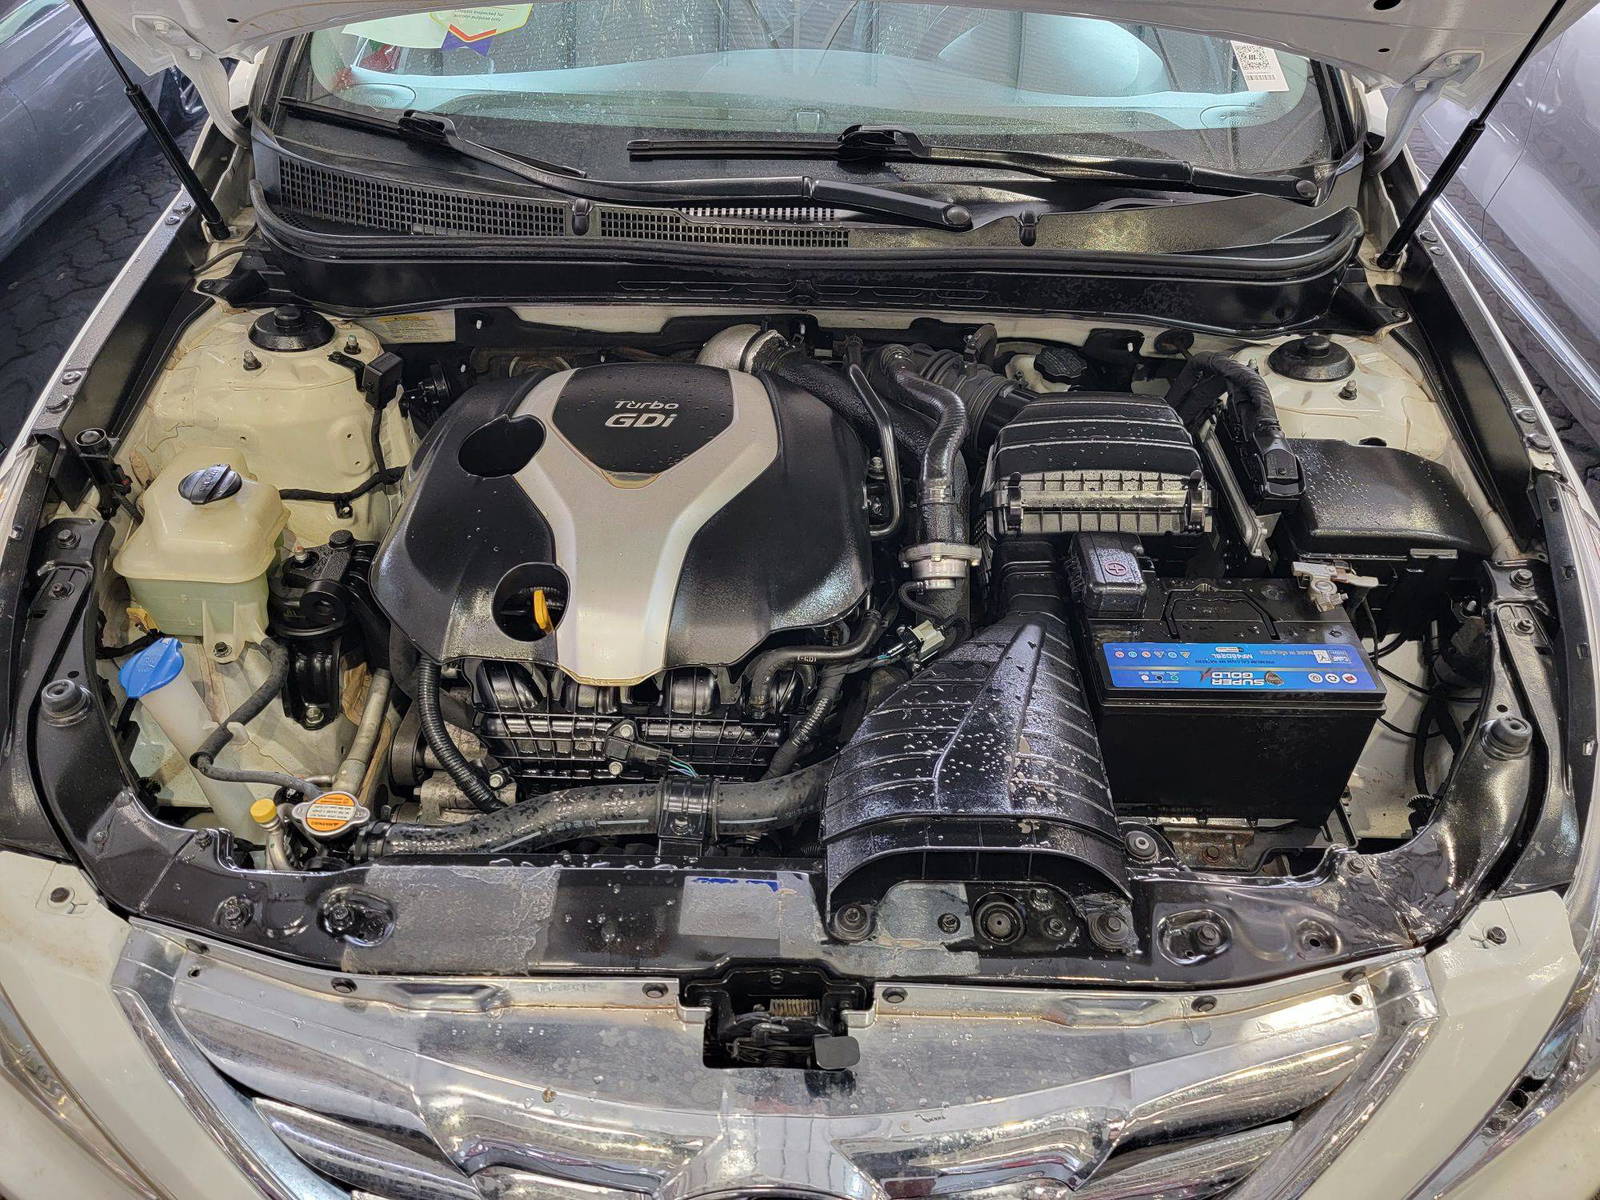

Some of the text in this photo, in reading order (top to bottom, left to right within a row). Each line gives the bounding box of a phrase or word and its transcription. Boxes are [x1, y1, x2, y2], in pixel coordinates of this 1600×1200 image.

[615, 400, 679, 410] Turbo
[605, 412, 678, 428] GDi
[1211, 671, 1254, 679] GOLD
